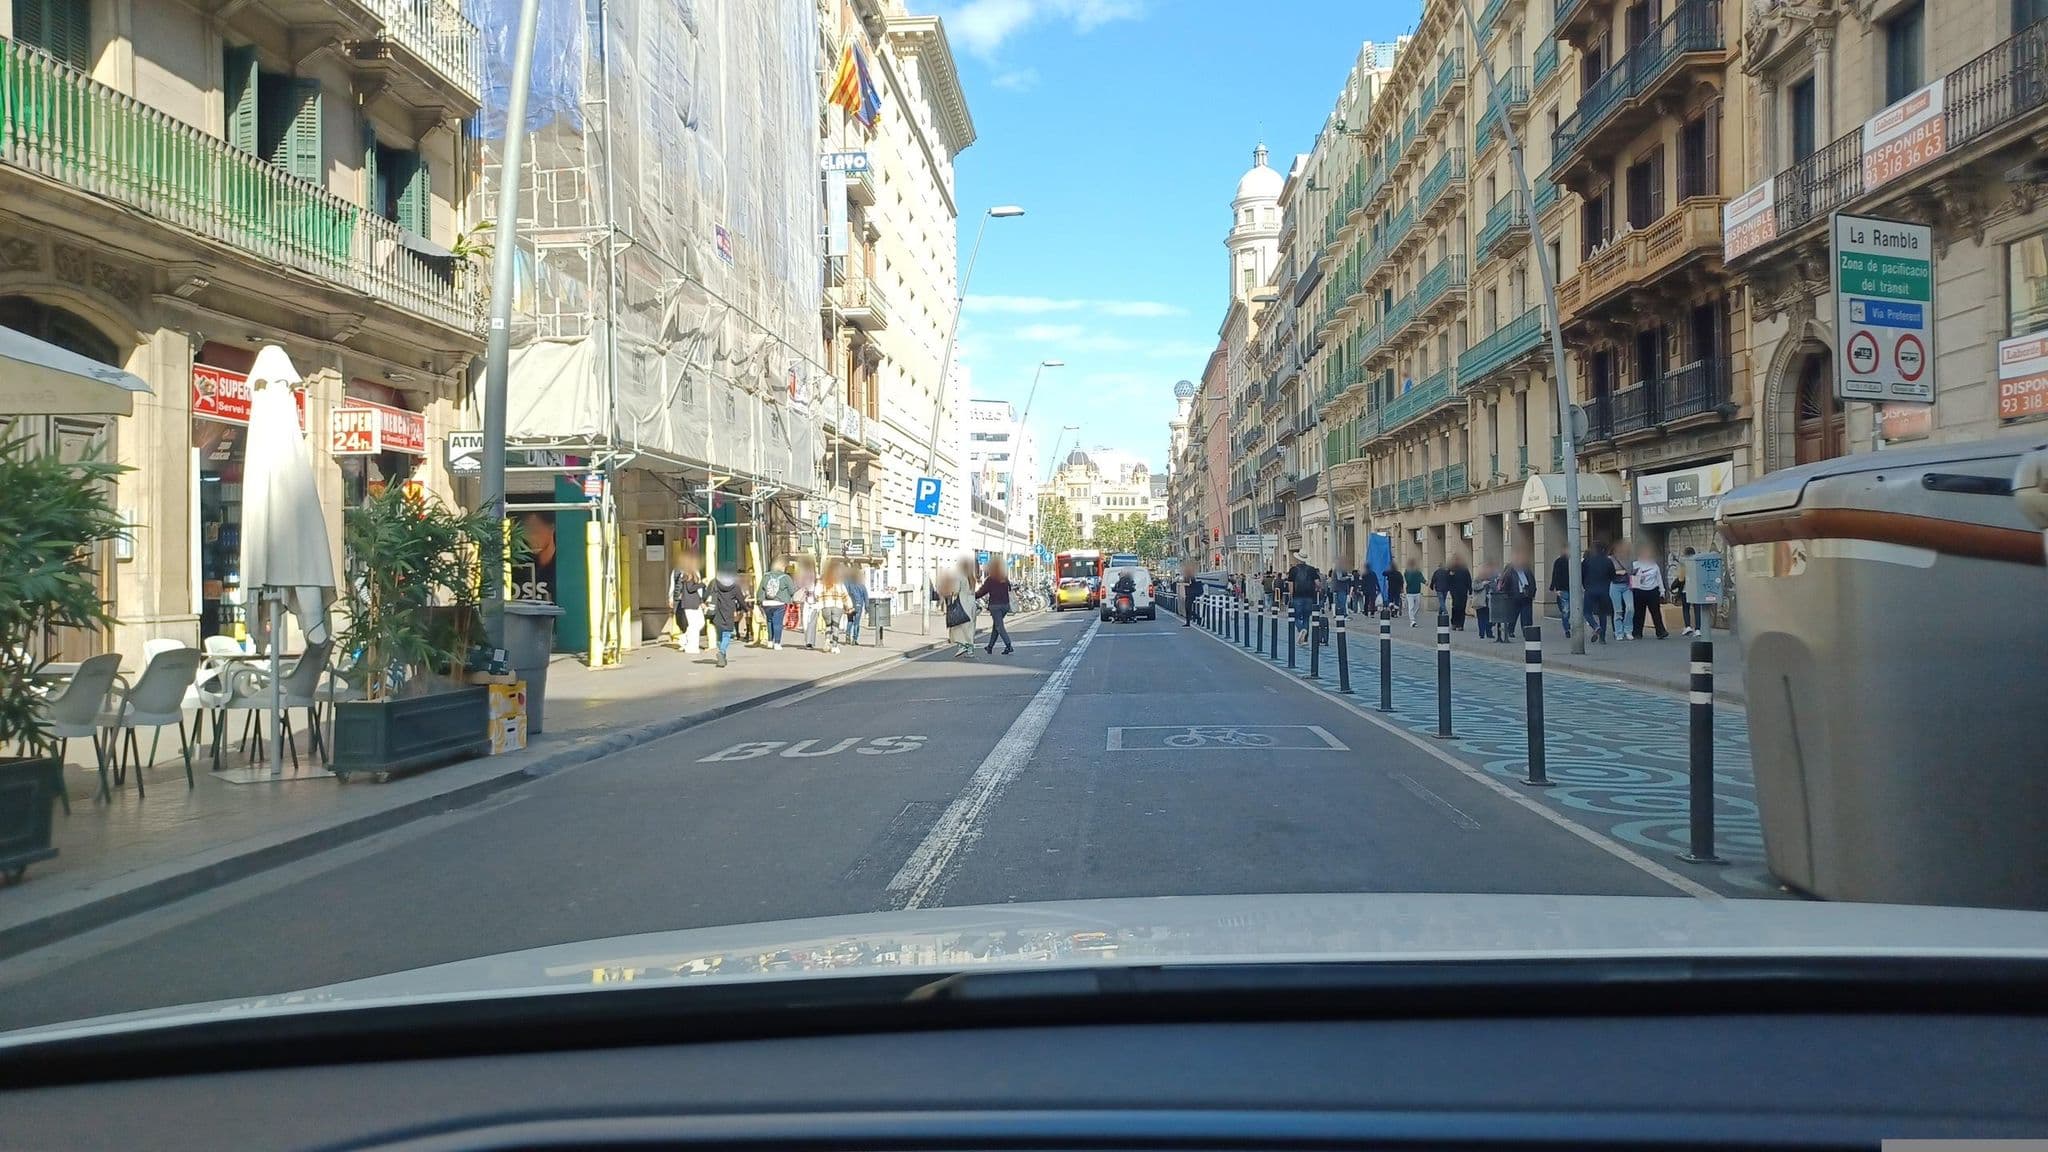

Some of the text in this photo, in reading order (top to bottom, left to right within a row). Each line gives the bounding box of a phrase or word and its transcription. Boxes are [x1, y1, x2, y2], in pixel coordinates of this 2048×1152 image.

[1866, 118, 1942, 170] DISPONIBLE
[1866, 135, 1942, 185] 93 318 36 63
[1850, 226, 1918, 249] La Rambla
[1841, 255, 1928, 278] Zona de pacificació
[1861, 278, 1876, 292] del
[1871, 307, 1884, 320] Via
[218, 400, 244, 414] Servei
[2002, 393, 2043, 413] 93 318
[334, 411, 372, 432] SUPER
[451, 436, 483, 448] ATM
[920, 480, 936, 500] P
[1675, 482, 1691, 492] LOCAL
[696, 735, 928, 763] BUS
